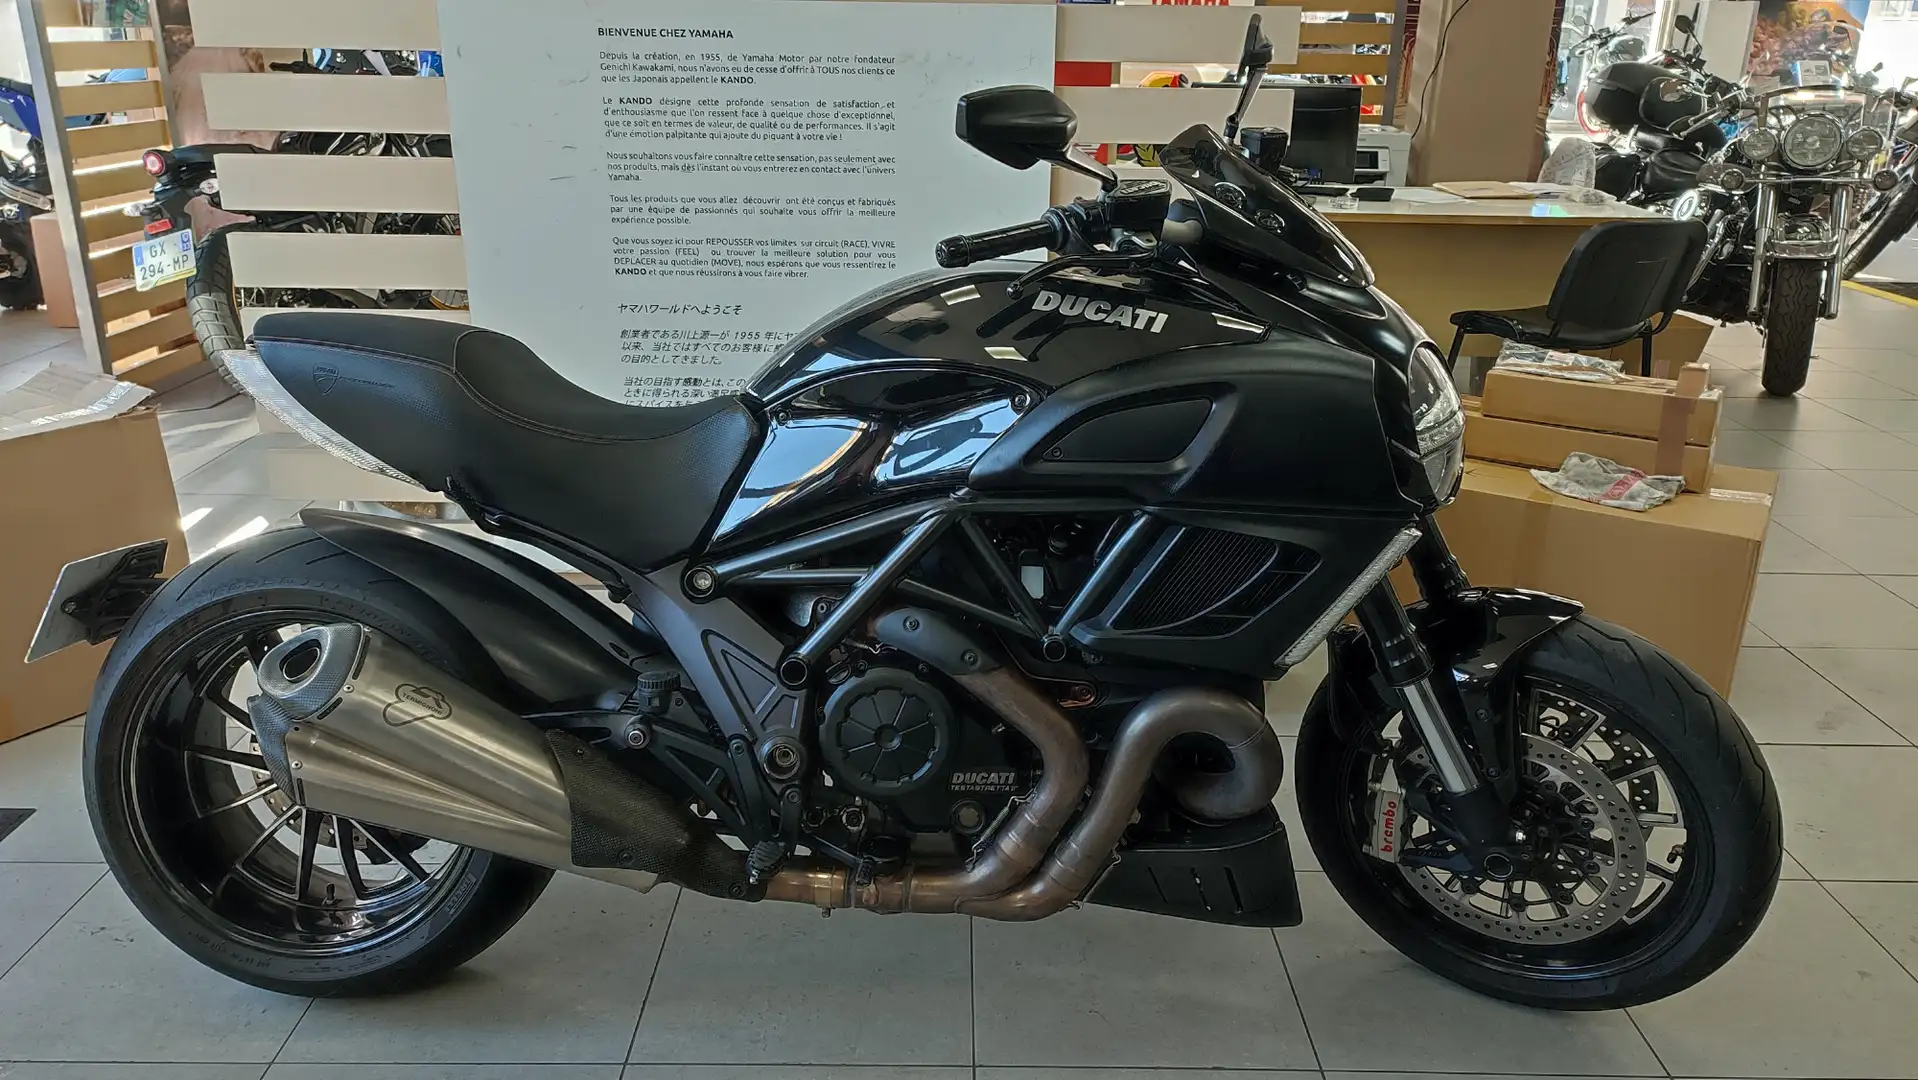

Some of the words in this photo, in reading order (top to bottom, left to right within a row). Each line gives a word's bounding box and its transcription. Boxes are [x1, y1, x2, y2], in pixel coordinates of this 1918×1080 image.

[598, 28, 657, 37] BIENVENUE
[660, 29, 686, 38] CHEZ
[688, 29, 734, 39] YAMAHA
[600, 52, 628, 61] Depuis
[742, 53, 774, 62] Yamaha
[779, 55, 804, 63] Motor
[854, 55, 895, 64] fondateur
[817, 66, 840, 74] TOUS
[858, 66, 884, 75] clients
[619, 74, 630, 82] les
[633, 75, 668, 84] Japonais
[670, 75, 709, 85] appellent
[726, 98, 764, 108] profonde
[771, 100, 809, 108] sensation
[708, 110, 739, 118] ressent
[742, 109, 759, 118] face
[771, 110, 804, 120] quelque
[807, 110, 830, 119] chose
[634, 119, 650, 127] soit
[750, 121, 778, 130] qualité
[666, 130, 707, 140] palpitante
[709, 131, 722, 140] qui
[723, 132, 749, 141] ajoute
[763, 132, 794, 141] piquant
[607, 152, 628, 160] Nous
[694, 152, 713, 161] faire
[834, 155, 876, 163] seulement
[661, 163, 680, 171] mais
[764, 165, 798, 173] entrerez
[631, 194, 643, 203] les
[645, 195, 679, 204] produits
[719, 196, 738, 204] allez
[743, 196, 780, 205] découvrir
[858, 198, 896, 207] fabriqués
[695, 206, 738, 216] passionnés
[743, 207, 755, 216] qui
[760, 207, 794, 216] souhaite
[821, 208, 842, 216] offrir
[859, 209, 896, 217] meilleure
[612, 215, 655, 225] expérience
[612, 237, 629, 246] Que
[706, 238, 754, 246] REPOUSSER
[771, 239, 797, 247] limites
[150, 241, 166, 258] GX
[640, 248, 670, 256] passion
[675, 247, 700, 257] (FEEL)
[727, 248, 756, 256] trouver
[774, 249, 811, 258] meilleure
[140, 254, 188, 281] 294-MP
[614, 257, 657, 266] DEPLACER
[843, 261, 886, 269] ressentirez
[618, 303, 743, 315] ヤマハワールドへようこそ
[1032, 290, 1169, 333] DUCATI
[952, 772, 1015, 784] DUCATI
[1381, 800, 1397, 853] brembo
